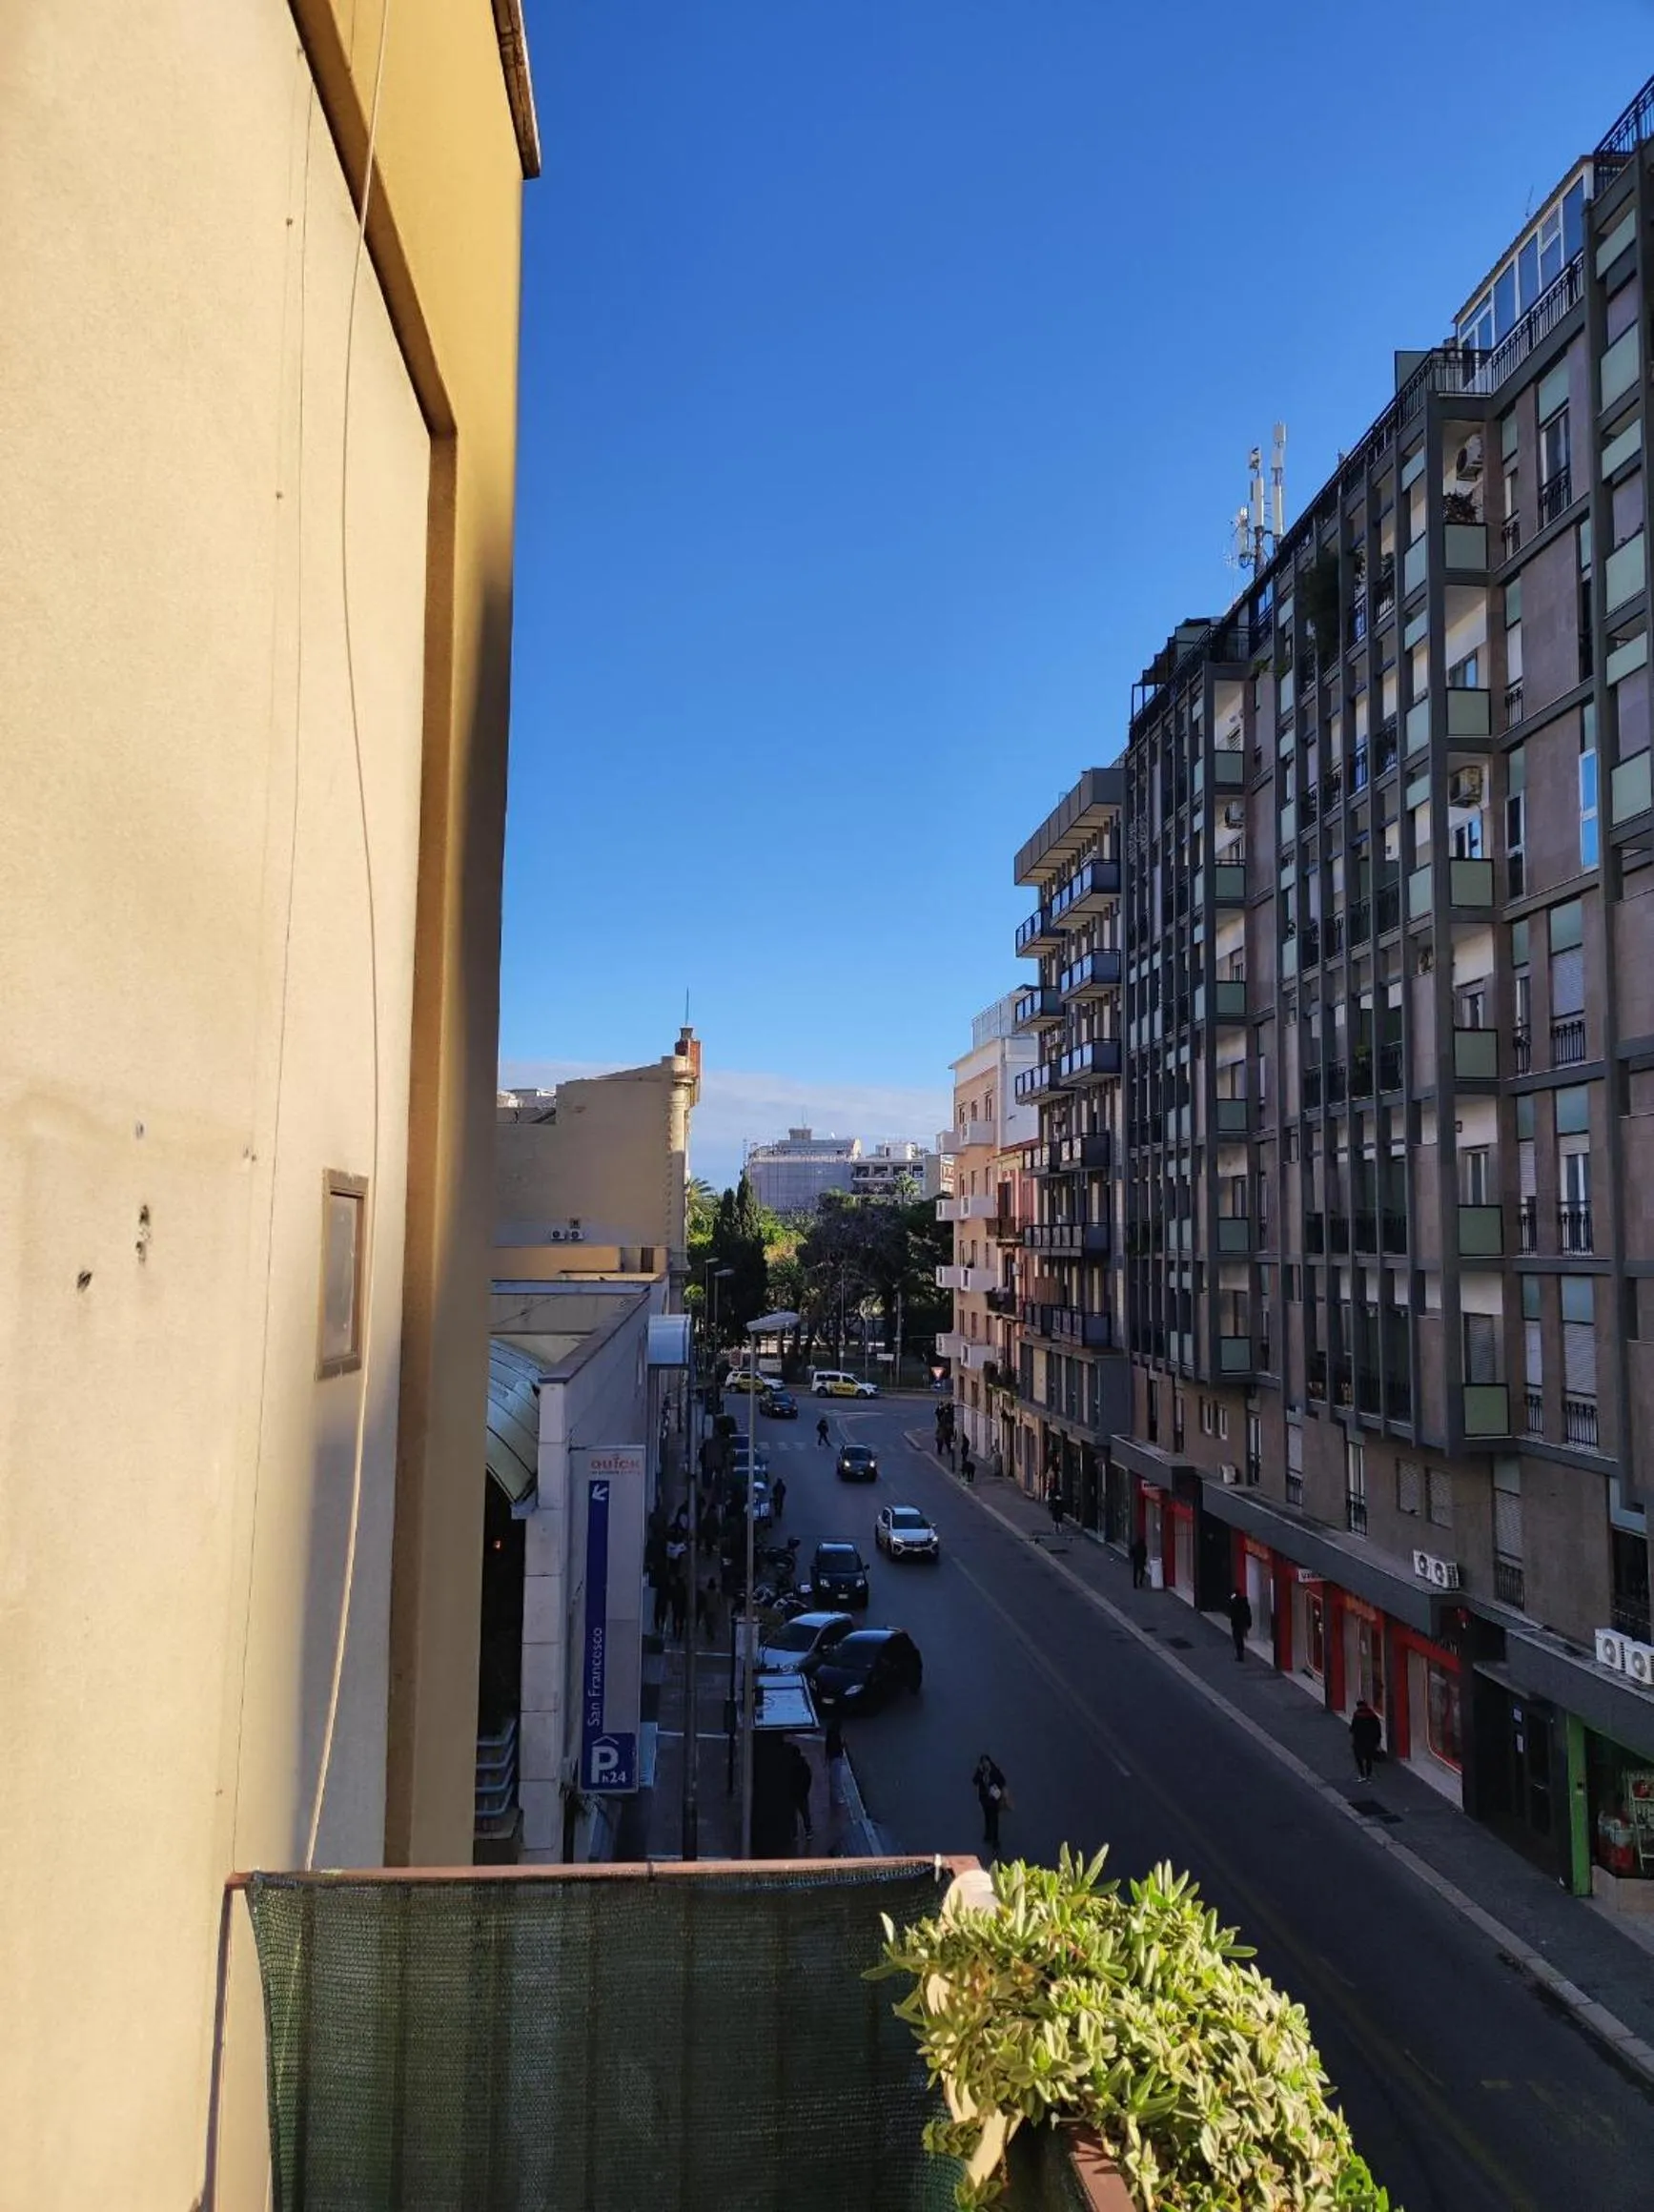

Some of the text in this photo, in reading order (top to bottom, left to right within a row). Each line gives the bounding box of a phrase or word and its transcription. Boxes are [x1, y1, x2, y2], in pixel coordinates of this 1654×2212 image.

[587, 1627, 603, 1727] San Francesco
[590, 1745, 620, 1784] P
[602, 1771, 626, 1784] h24
